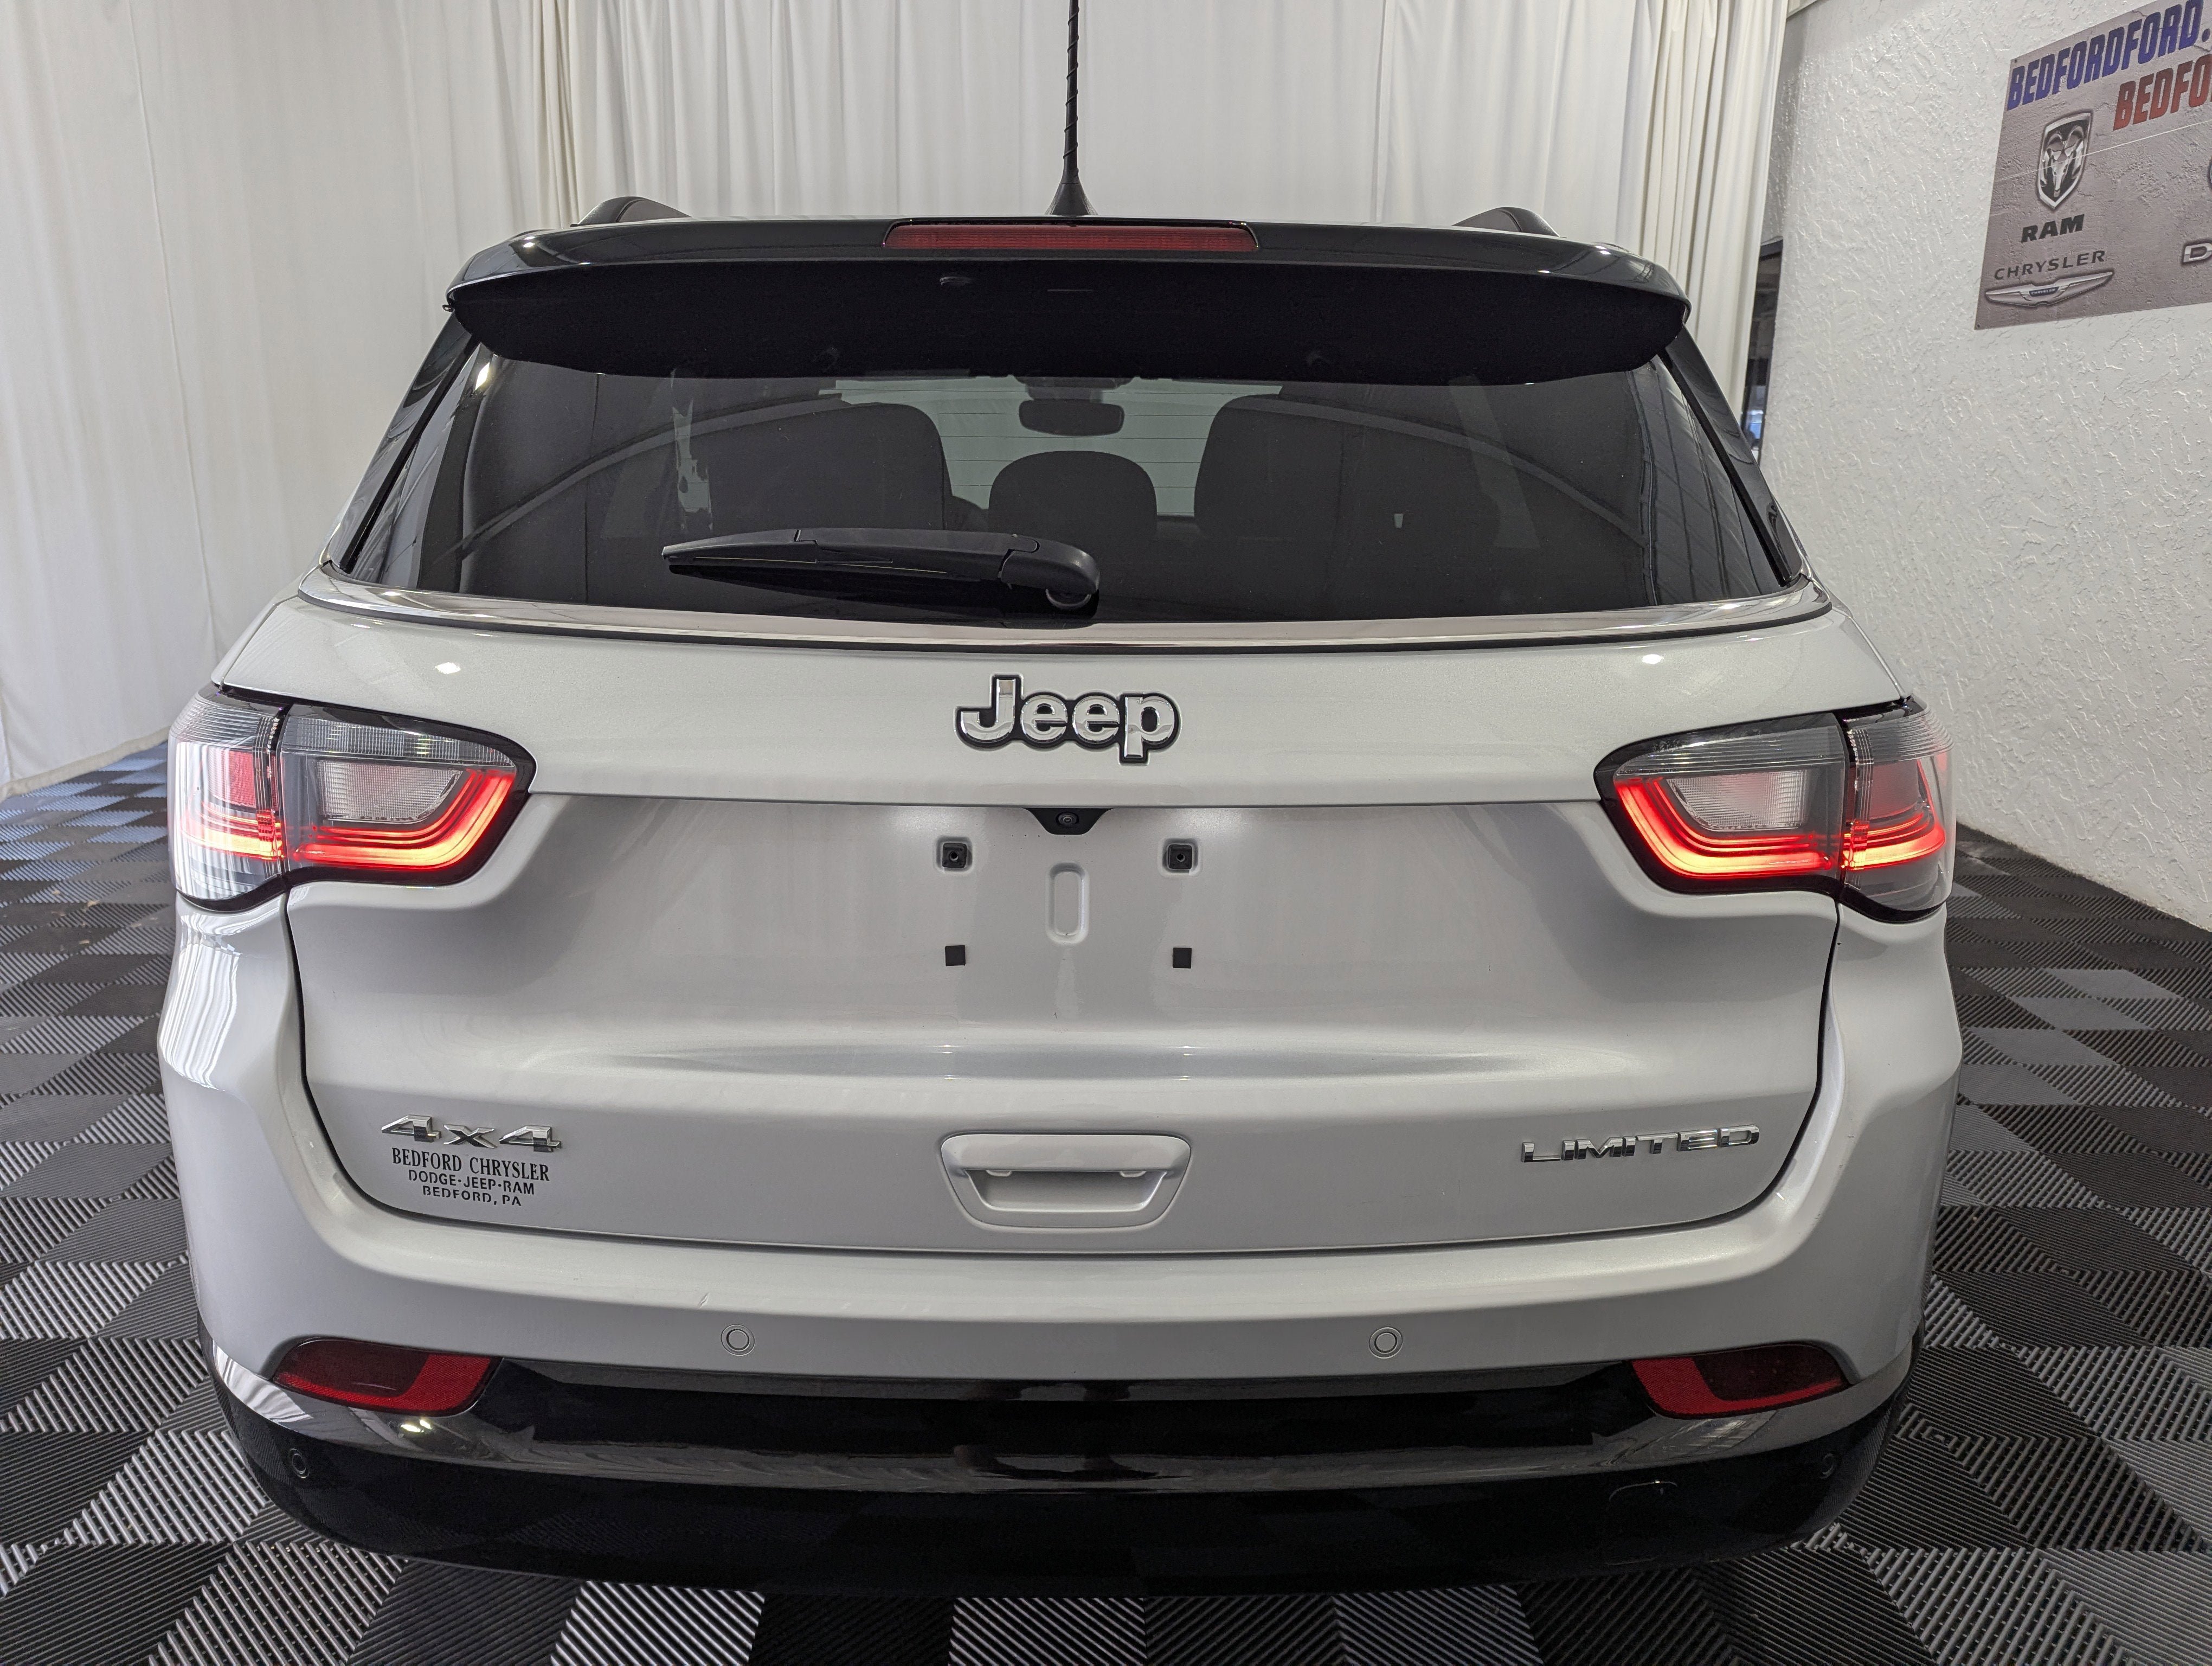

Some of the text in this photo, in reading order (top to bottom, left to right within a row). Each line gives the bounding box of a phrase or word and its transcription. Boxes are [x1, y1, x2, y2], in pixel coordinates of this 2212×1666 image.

[2113, 53, 2212, 131] BEDFO
[2021, 214, 2085, 244] RAM
[1994, 249, 2105, 280] CHRYSLER
[956, 674, 1181, 765] Jeep
[1522, 1124, 1760, 1163] LIMITED
[391, 1147, 550, 1181] BEDFORD CHRYSLER
[423, 1186, 522, 1206] BEDFORD, PA
